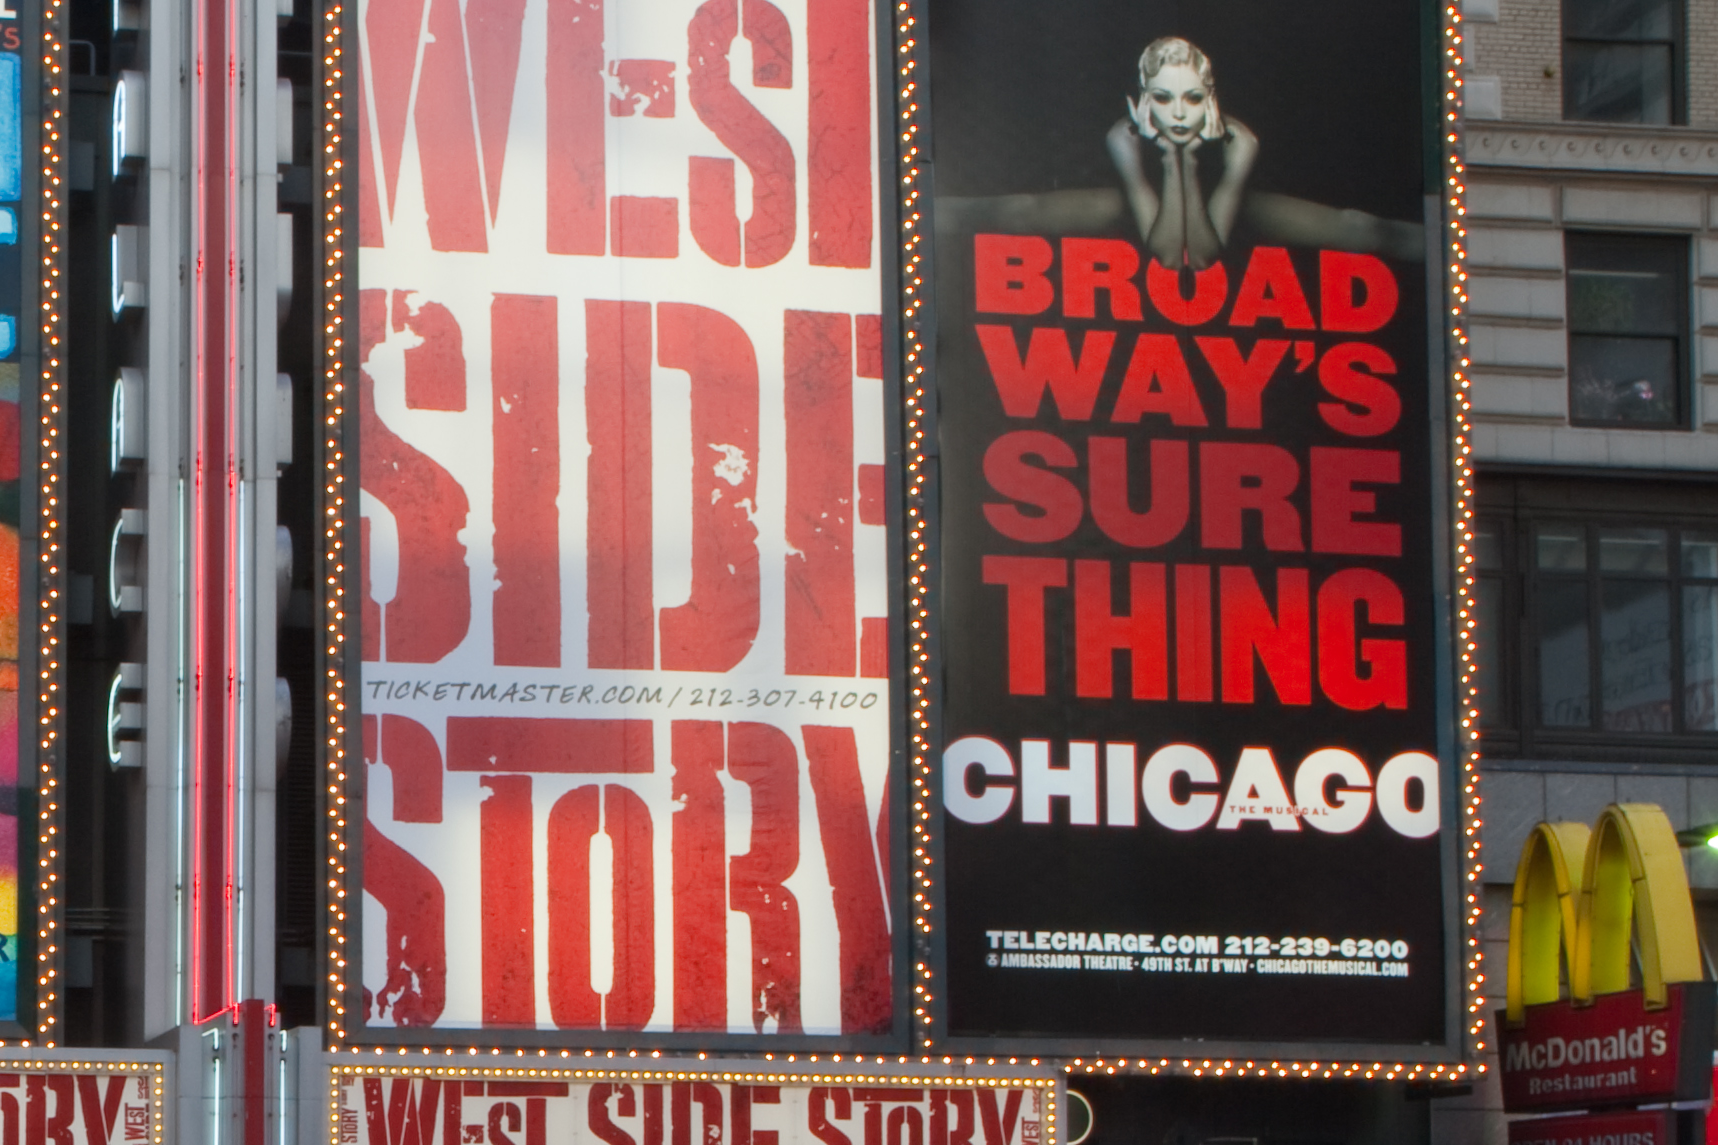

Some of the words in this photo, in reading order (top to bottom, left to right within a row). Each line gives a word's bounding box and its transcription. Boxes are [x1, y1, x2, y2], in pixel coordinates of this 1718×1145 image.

[974, 233, 1399, 333] BROAD
[975, 324, 1402, 437] WAY'S
[359, 288, 889, 678] SIDE
[982, 430, 1402, 557] SURE
[982, 555, 1408, 711] THING
[942, 736, 1440, 838] CHICAGO
[1229, 804, 1259, 815] THE
[1263, 805, 1329, 817] MUSICAL
[362, 712, 893, 1036] STORY
[986, 930, 1218, 955] TELECHARGE.COM
[1224, 936, 1409, 960] 212-239-6200
[1000, 953, 1081, 970] AMBASSADOR
[1141, 956, 1171, 972] 49TH
[1196, 958, 1208, 973] AT
[1256, 960, 1409, 978] CHICAGOTHEMUSICAL.COM
[1505, 1025, 1667, 1072] McDonald's
[1529, 1067, 1637, 1095] Restaurant
